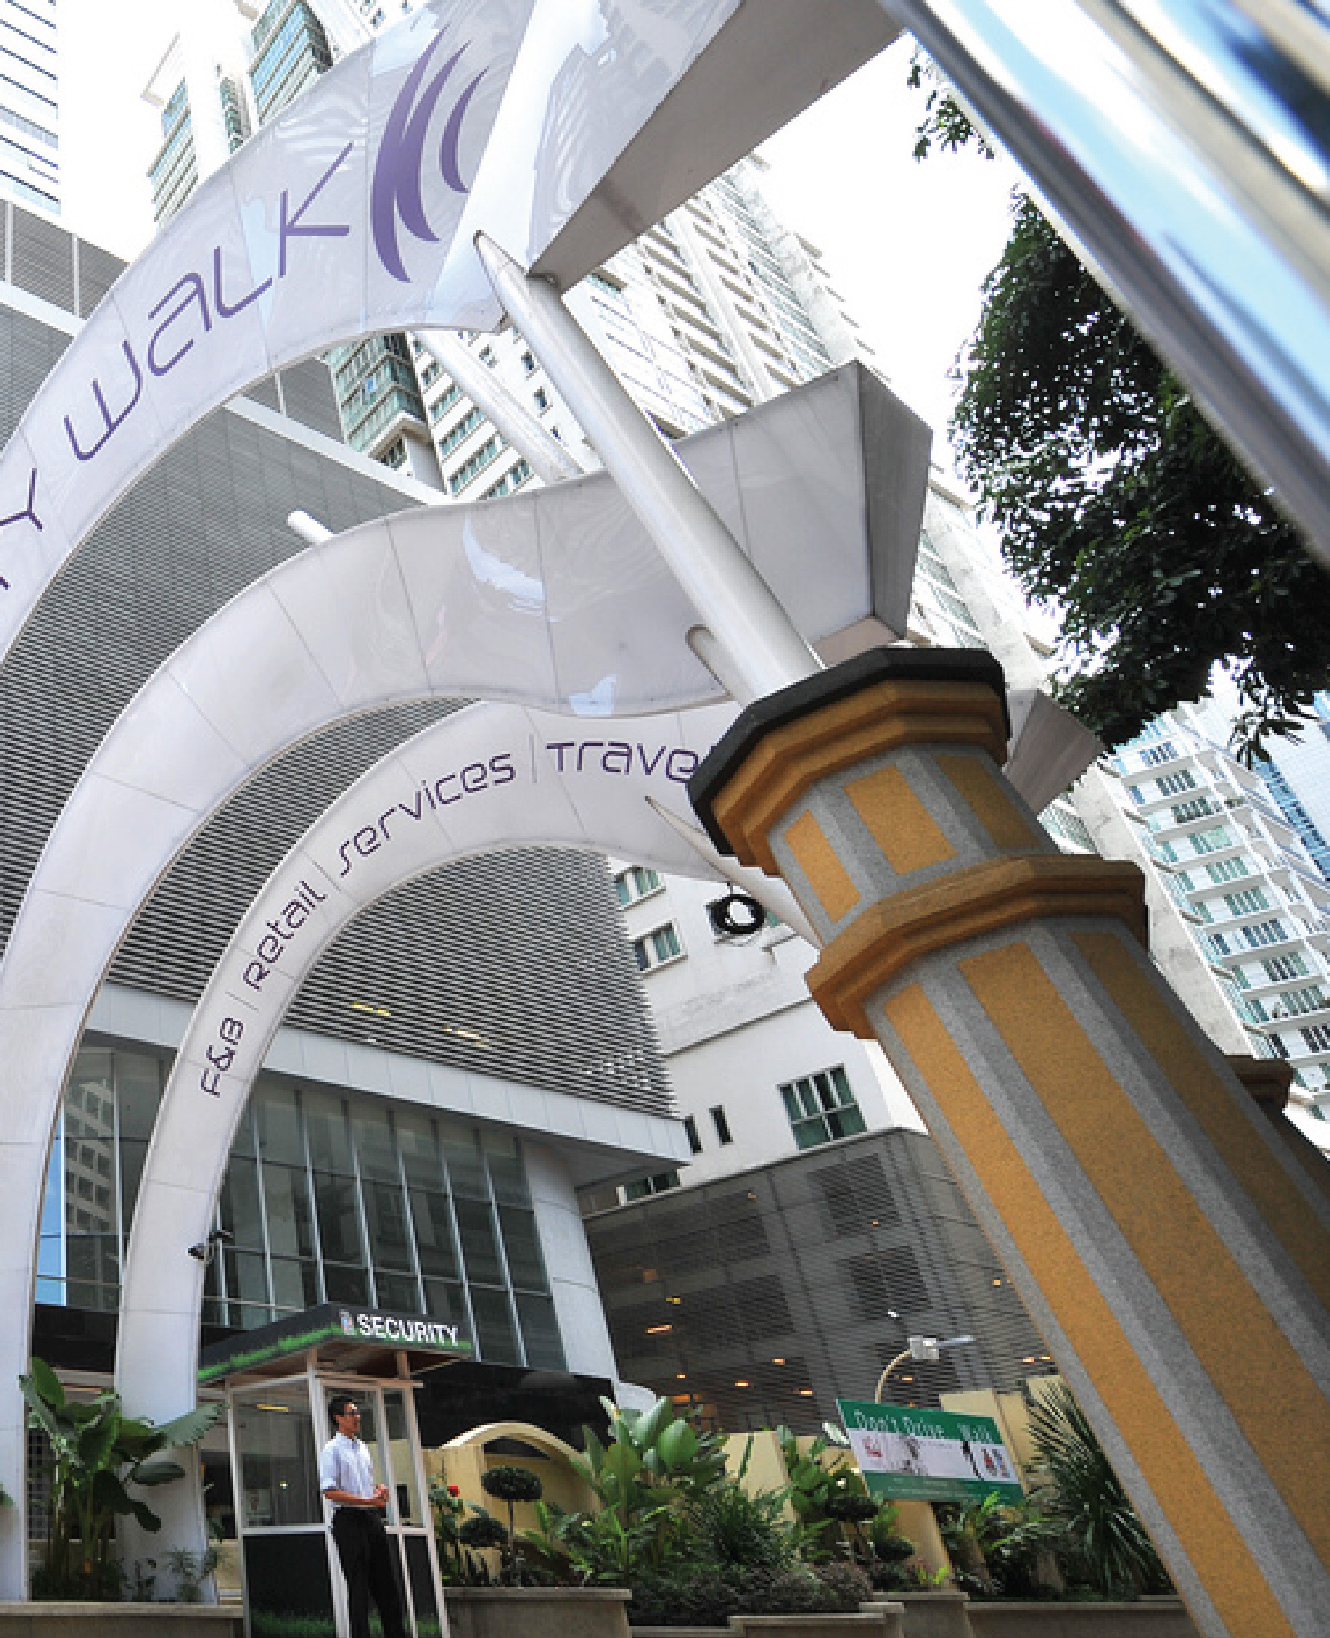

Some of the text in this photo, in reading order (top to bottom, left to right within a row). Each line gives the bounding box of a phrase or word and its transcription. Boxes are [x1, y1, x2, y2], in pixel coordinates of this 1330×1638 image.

[201, 1016, 245, 1098] F&B
[546, 741, 716, 784] Trave
[357, 1313, 459, 1346] SECURITY
